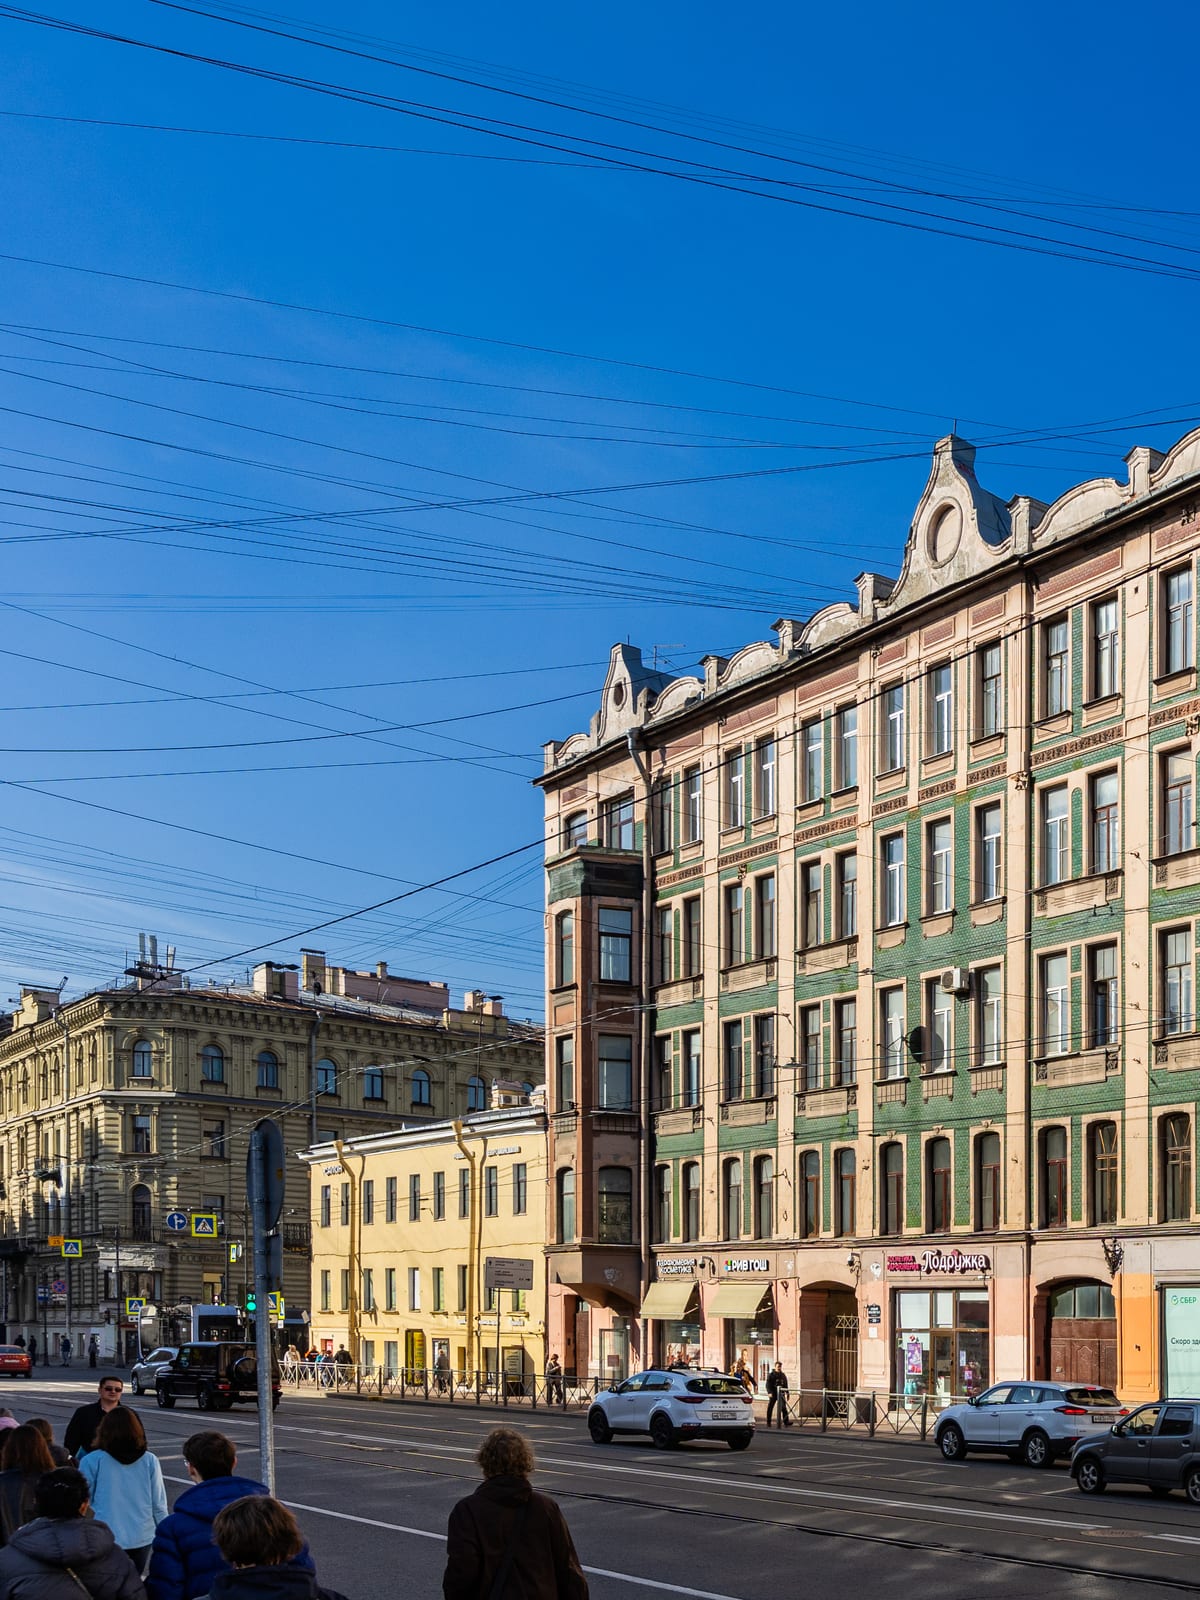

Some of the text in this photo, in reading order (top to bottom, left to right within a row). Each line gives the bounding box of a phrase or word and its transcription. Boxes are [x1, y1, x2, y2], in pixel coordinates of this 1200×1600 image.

[920, 1250, 986, 1273] Подружка
[1180, 1296, 1197, 1304] СБЕР
[1170, 1337, 1191, 1346] Скоро
